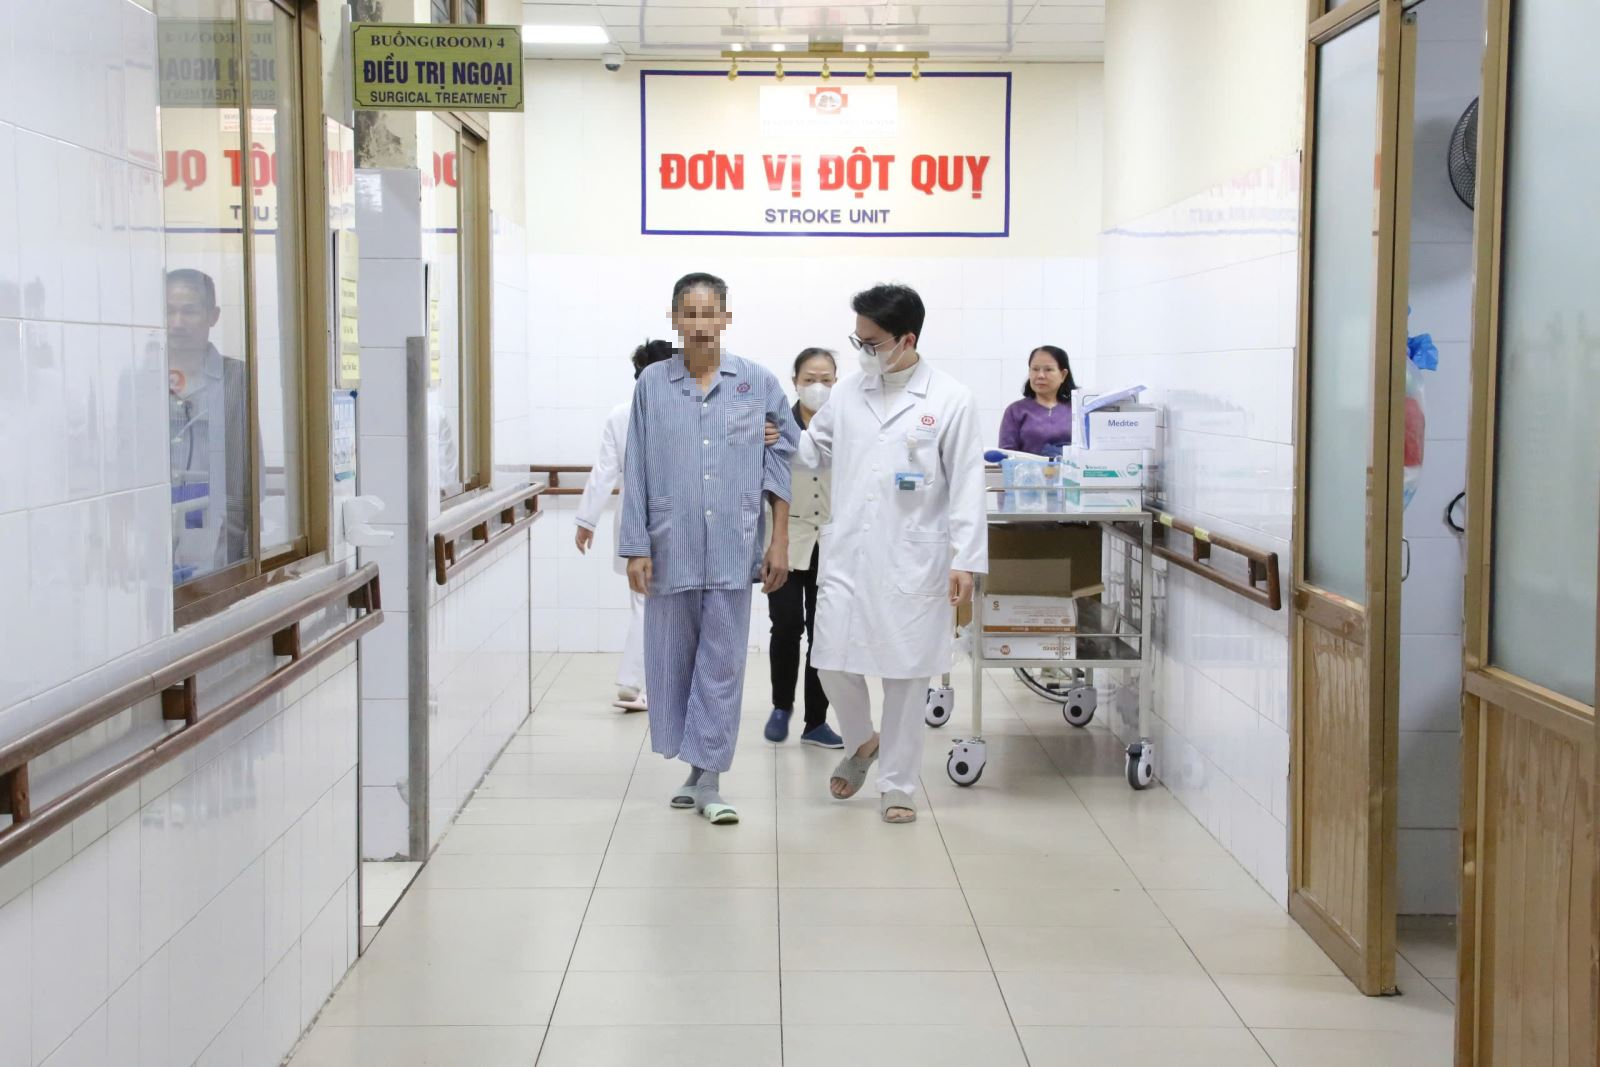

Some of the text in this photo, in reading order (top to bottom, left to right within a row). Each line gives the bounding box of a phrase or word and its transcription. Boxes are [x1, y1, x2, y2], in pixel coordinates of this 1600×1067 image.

[497, 38, 505, 48] 4
[363, 52, 513, 91] ĐIỀU TRỊ NGOẠI
[370, 91, 507, 105] SURGICAL TREATMENT
[659, 146, 991, 199] ĐƠN VỊ ĐỘT QUỴ
[764, 208, 890, 224] STROKE UNIT
[1107, 419, 1139, 427] Meditec
[992, 600, 999, 609] S
